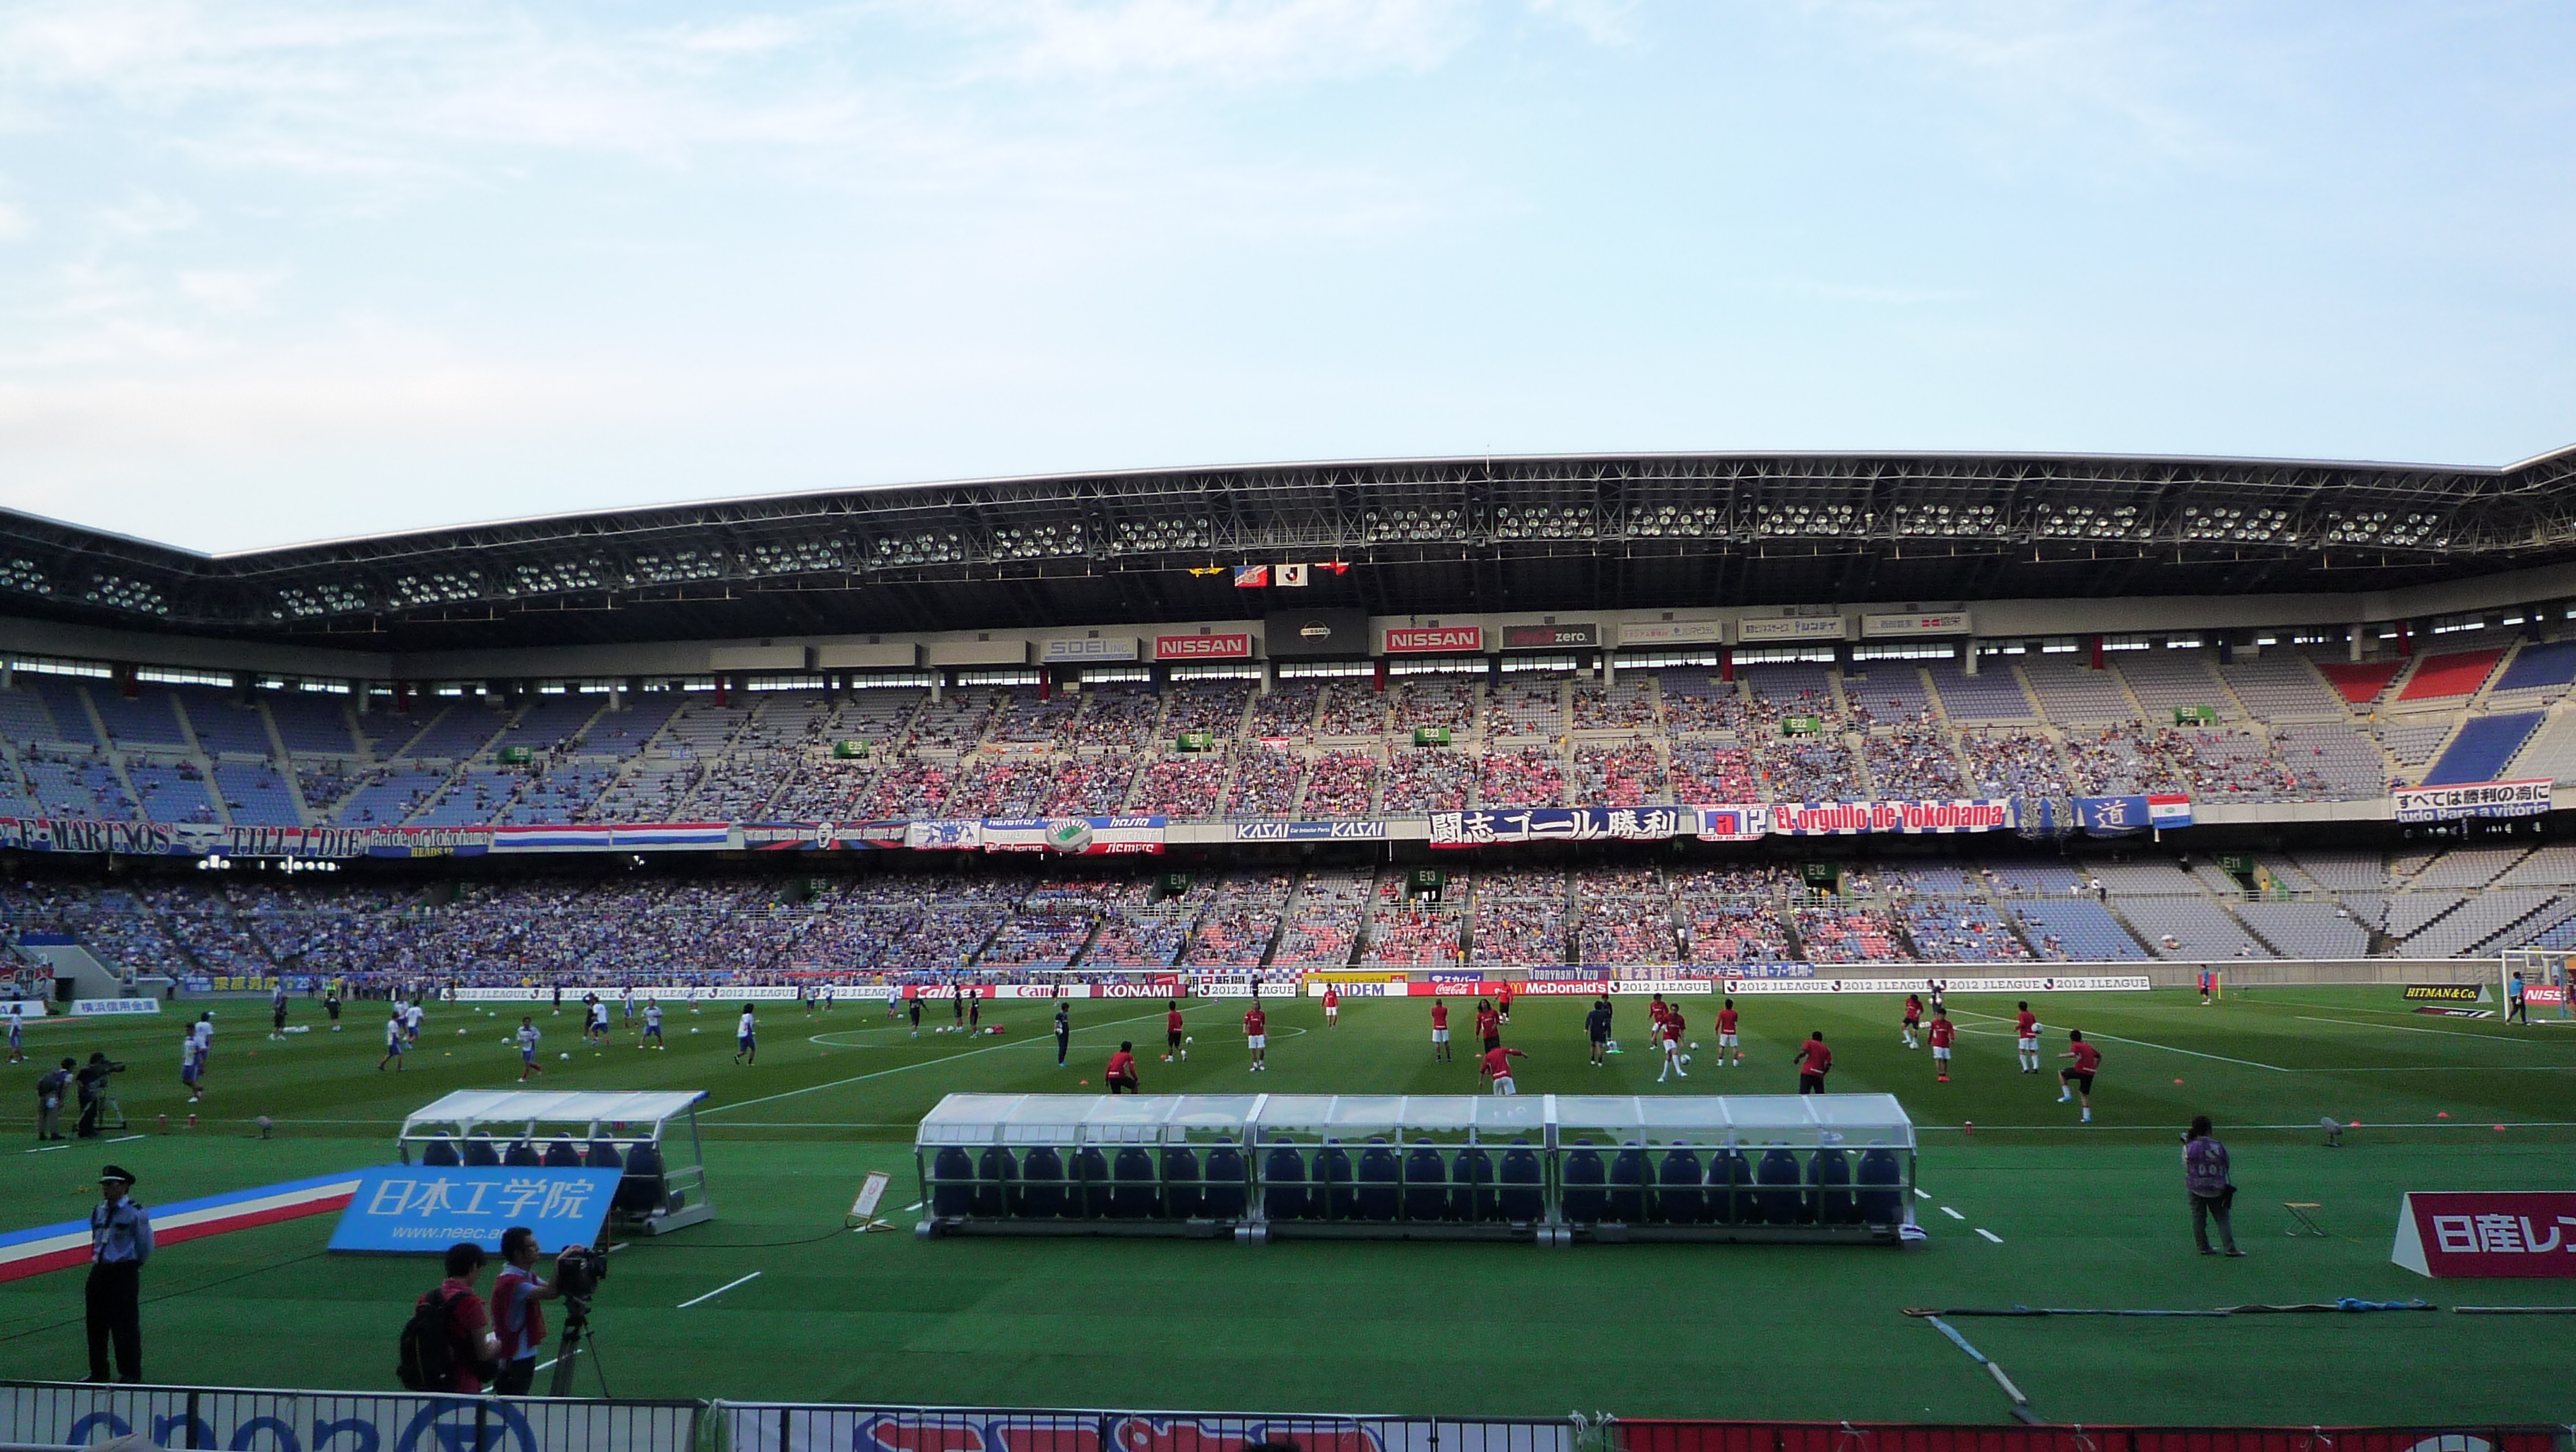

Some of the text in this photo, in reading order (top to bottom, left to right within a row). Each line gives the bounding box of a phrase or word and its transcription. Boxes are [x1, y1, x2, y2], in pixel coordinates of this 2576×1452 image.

[1390, 631, 1475, 648] NISSAN
[1161, 638, 1243, 655] NISSAN
[1791, 718, 1807, 727] E22
[1424, 728, 1439, 737] E23
[849, 741, 862, 750] E25
[1797, 805, 1869, 832] orgullo
[1872, 805, 1896, 829] de
[1901, 803, 2004, 828] Yokohama
[2094, 799, 2137, 831] 道
[2397, 810, 2434, 823] tudo
[2479, 807, 2490, 817] a
[1109, 817, 1150, 828] hasta
[773, 828, 797, 840] nuestro
[799, 828, 816, 840] amor
[835, 827, 861, 840] estamos
[862, 826, 890, 841] siempre
[1236, 823, 1290, 839] KASAI
[1330, 821, 1384, 837] KASAI
[228, 826, 365, 857] TILL I DIE
[371, 828, 488, 847] Pride of Yokohama
[1105, 843, 1154, 853] siempre
[2224, 857, 2241, 868] E11
[1808, 864, 1825, 875] E12
[1171, 874, 1186, 885] E14
[1419, 871, 1436, 881] E13
[811, 879, 826, 889] E15
[1576, 968, 1599, 980] YUZO
[1773, 965, 1782, 977] 7
[917, 984, 984, 999] Calbee
[1103, 984, 1173, 998] KONAMI
[1212, 986, 1239, 994] 2012
[1525, 982, 1606, 993] McDonald's
[1623, 982, 1650, 992] 2012
[1654, 982, 1710, 992] J.LEAGUE
[1739, 982, 1768, 992] 2012
[1772, 982, 1827, 991] J.LEAGUE
[1844, 982, 1873, 991] 2012
[1949, 981, 1978, 990] 2012
[1983, 981, 2040, 989] J.LEAGUE
[2056, 980, 2085, 989] 2012
[2090, 979, 2148, 988] J.LEAGUE
[540, 989, 564, 999] 202
[719, 989, 744, 998] 2012
[747, 989, 796, 998] J.LEAGUE
[2525, 989, 2567, 1001] NISS
[81, 1001, 155, 1013] 横浜信用金庫
[366, 1177, 595, 1219] 日本工学院
